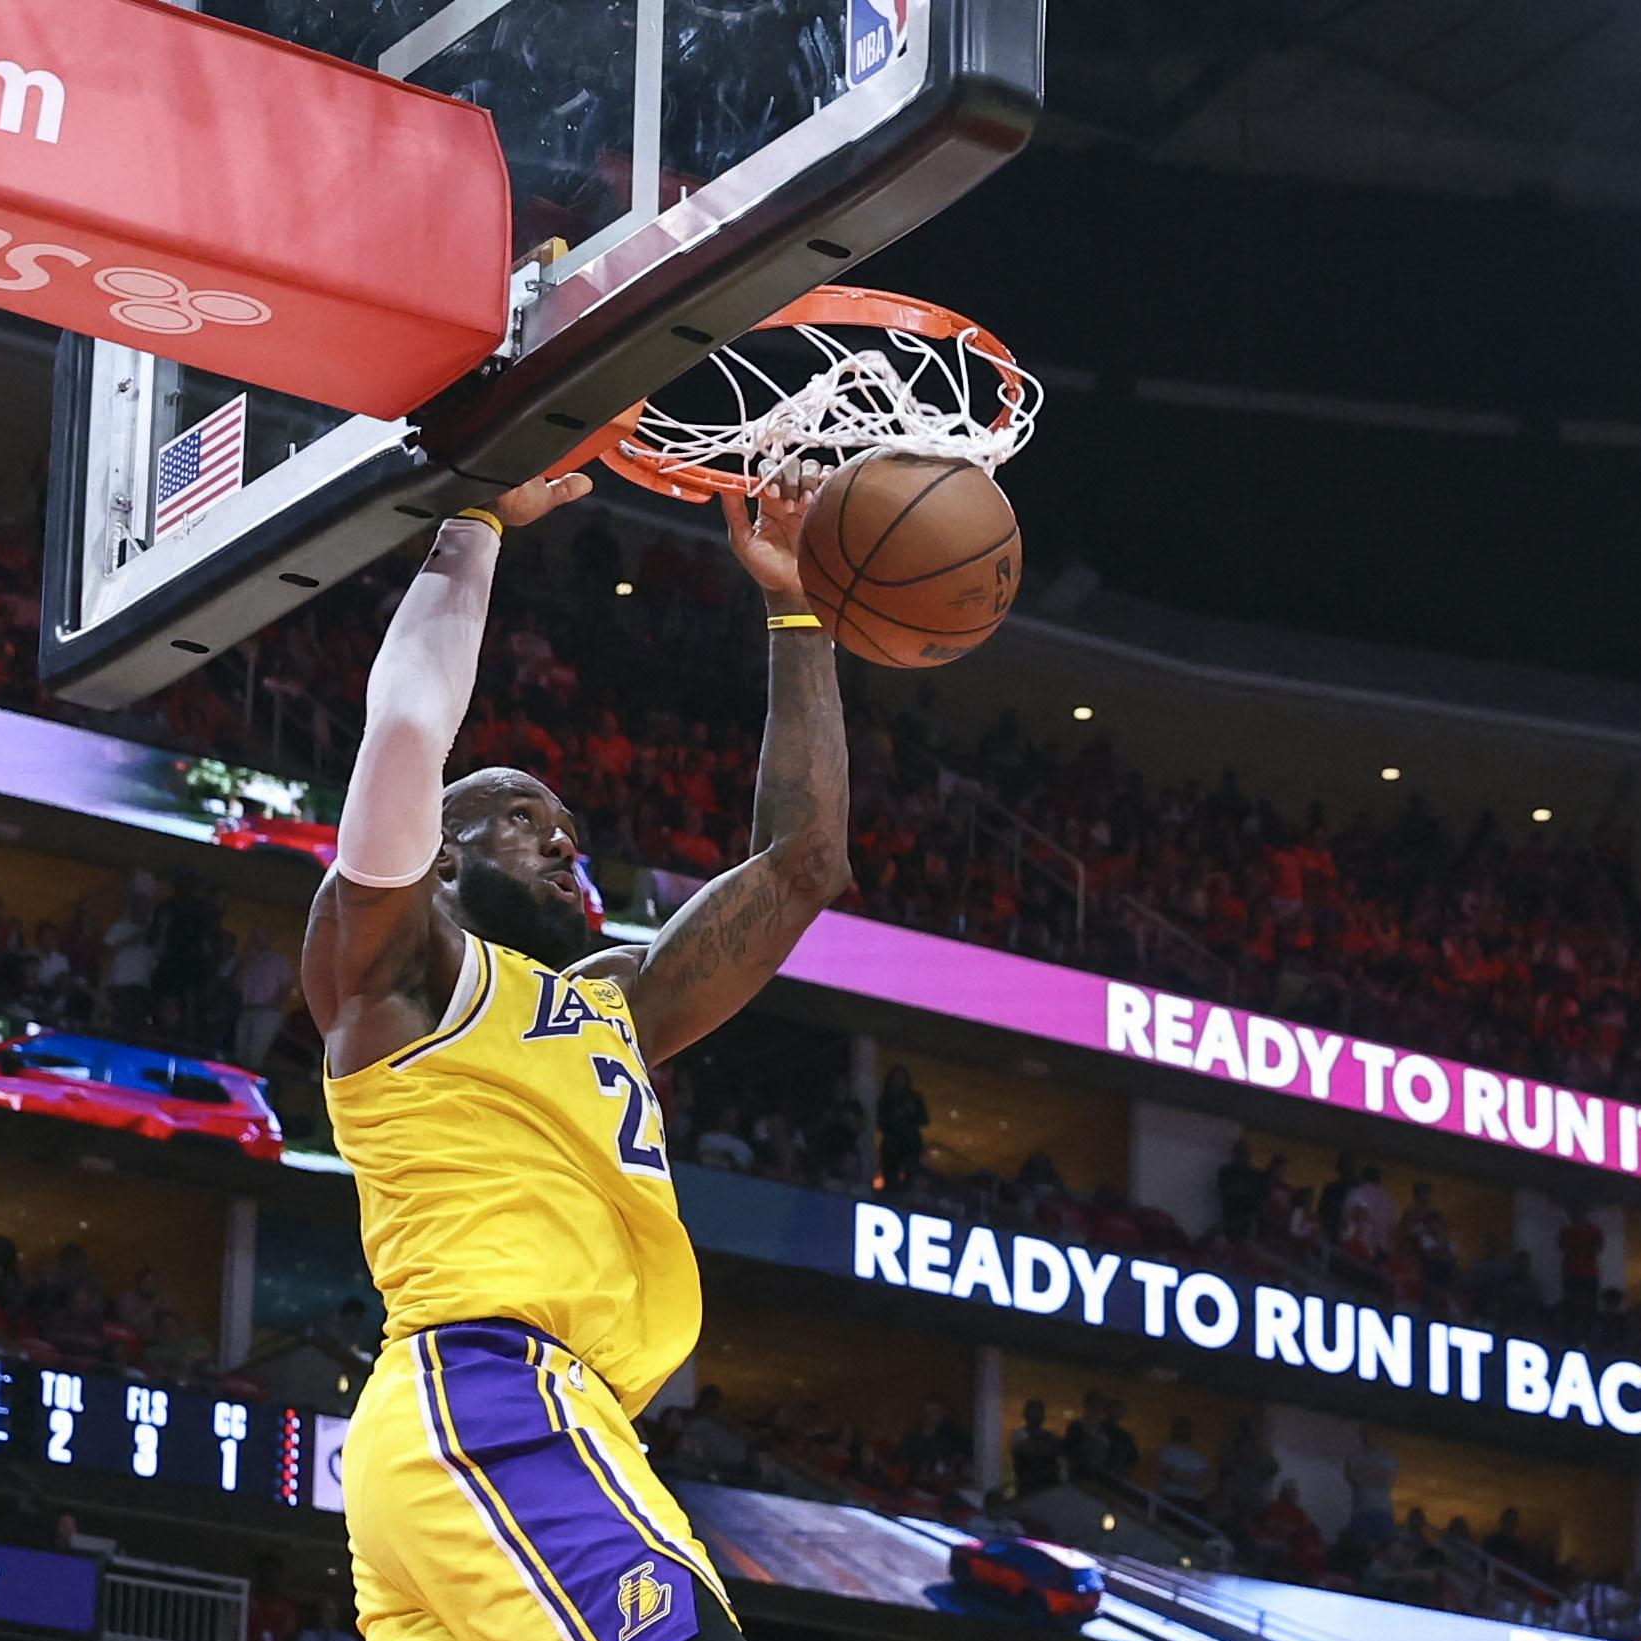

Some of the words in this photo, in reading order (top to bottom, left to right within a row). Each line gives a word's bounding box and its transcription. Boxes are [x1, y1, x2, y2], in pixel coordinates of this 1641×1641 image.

[855, 25, 887, 76] NBA
[1106, 981, 1350, 1102] READY
[1353, 1041, 1451, 1124] TO
[1462, 1067, 1612, 1163] RUN
[853, 1202, 1121, 1328] READY
[1131, 1260, 1240, 1349] TO
[1252, 1284, 1413, 1389] RUN
[1426, 1320, 1493, 1402] IT
[40, 1370, 85, 1413] TOL
[125, 1385, 169, 1428] FLS
[47, 1409, 74, 1464] 2
[132, 1423, 159, 1478] 3
[220, 1438, 238, 1491] 1
